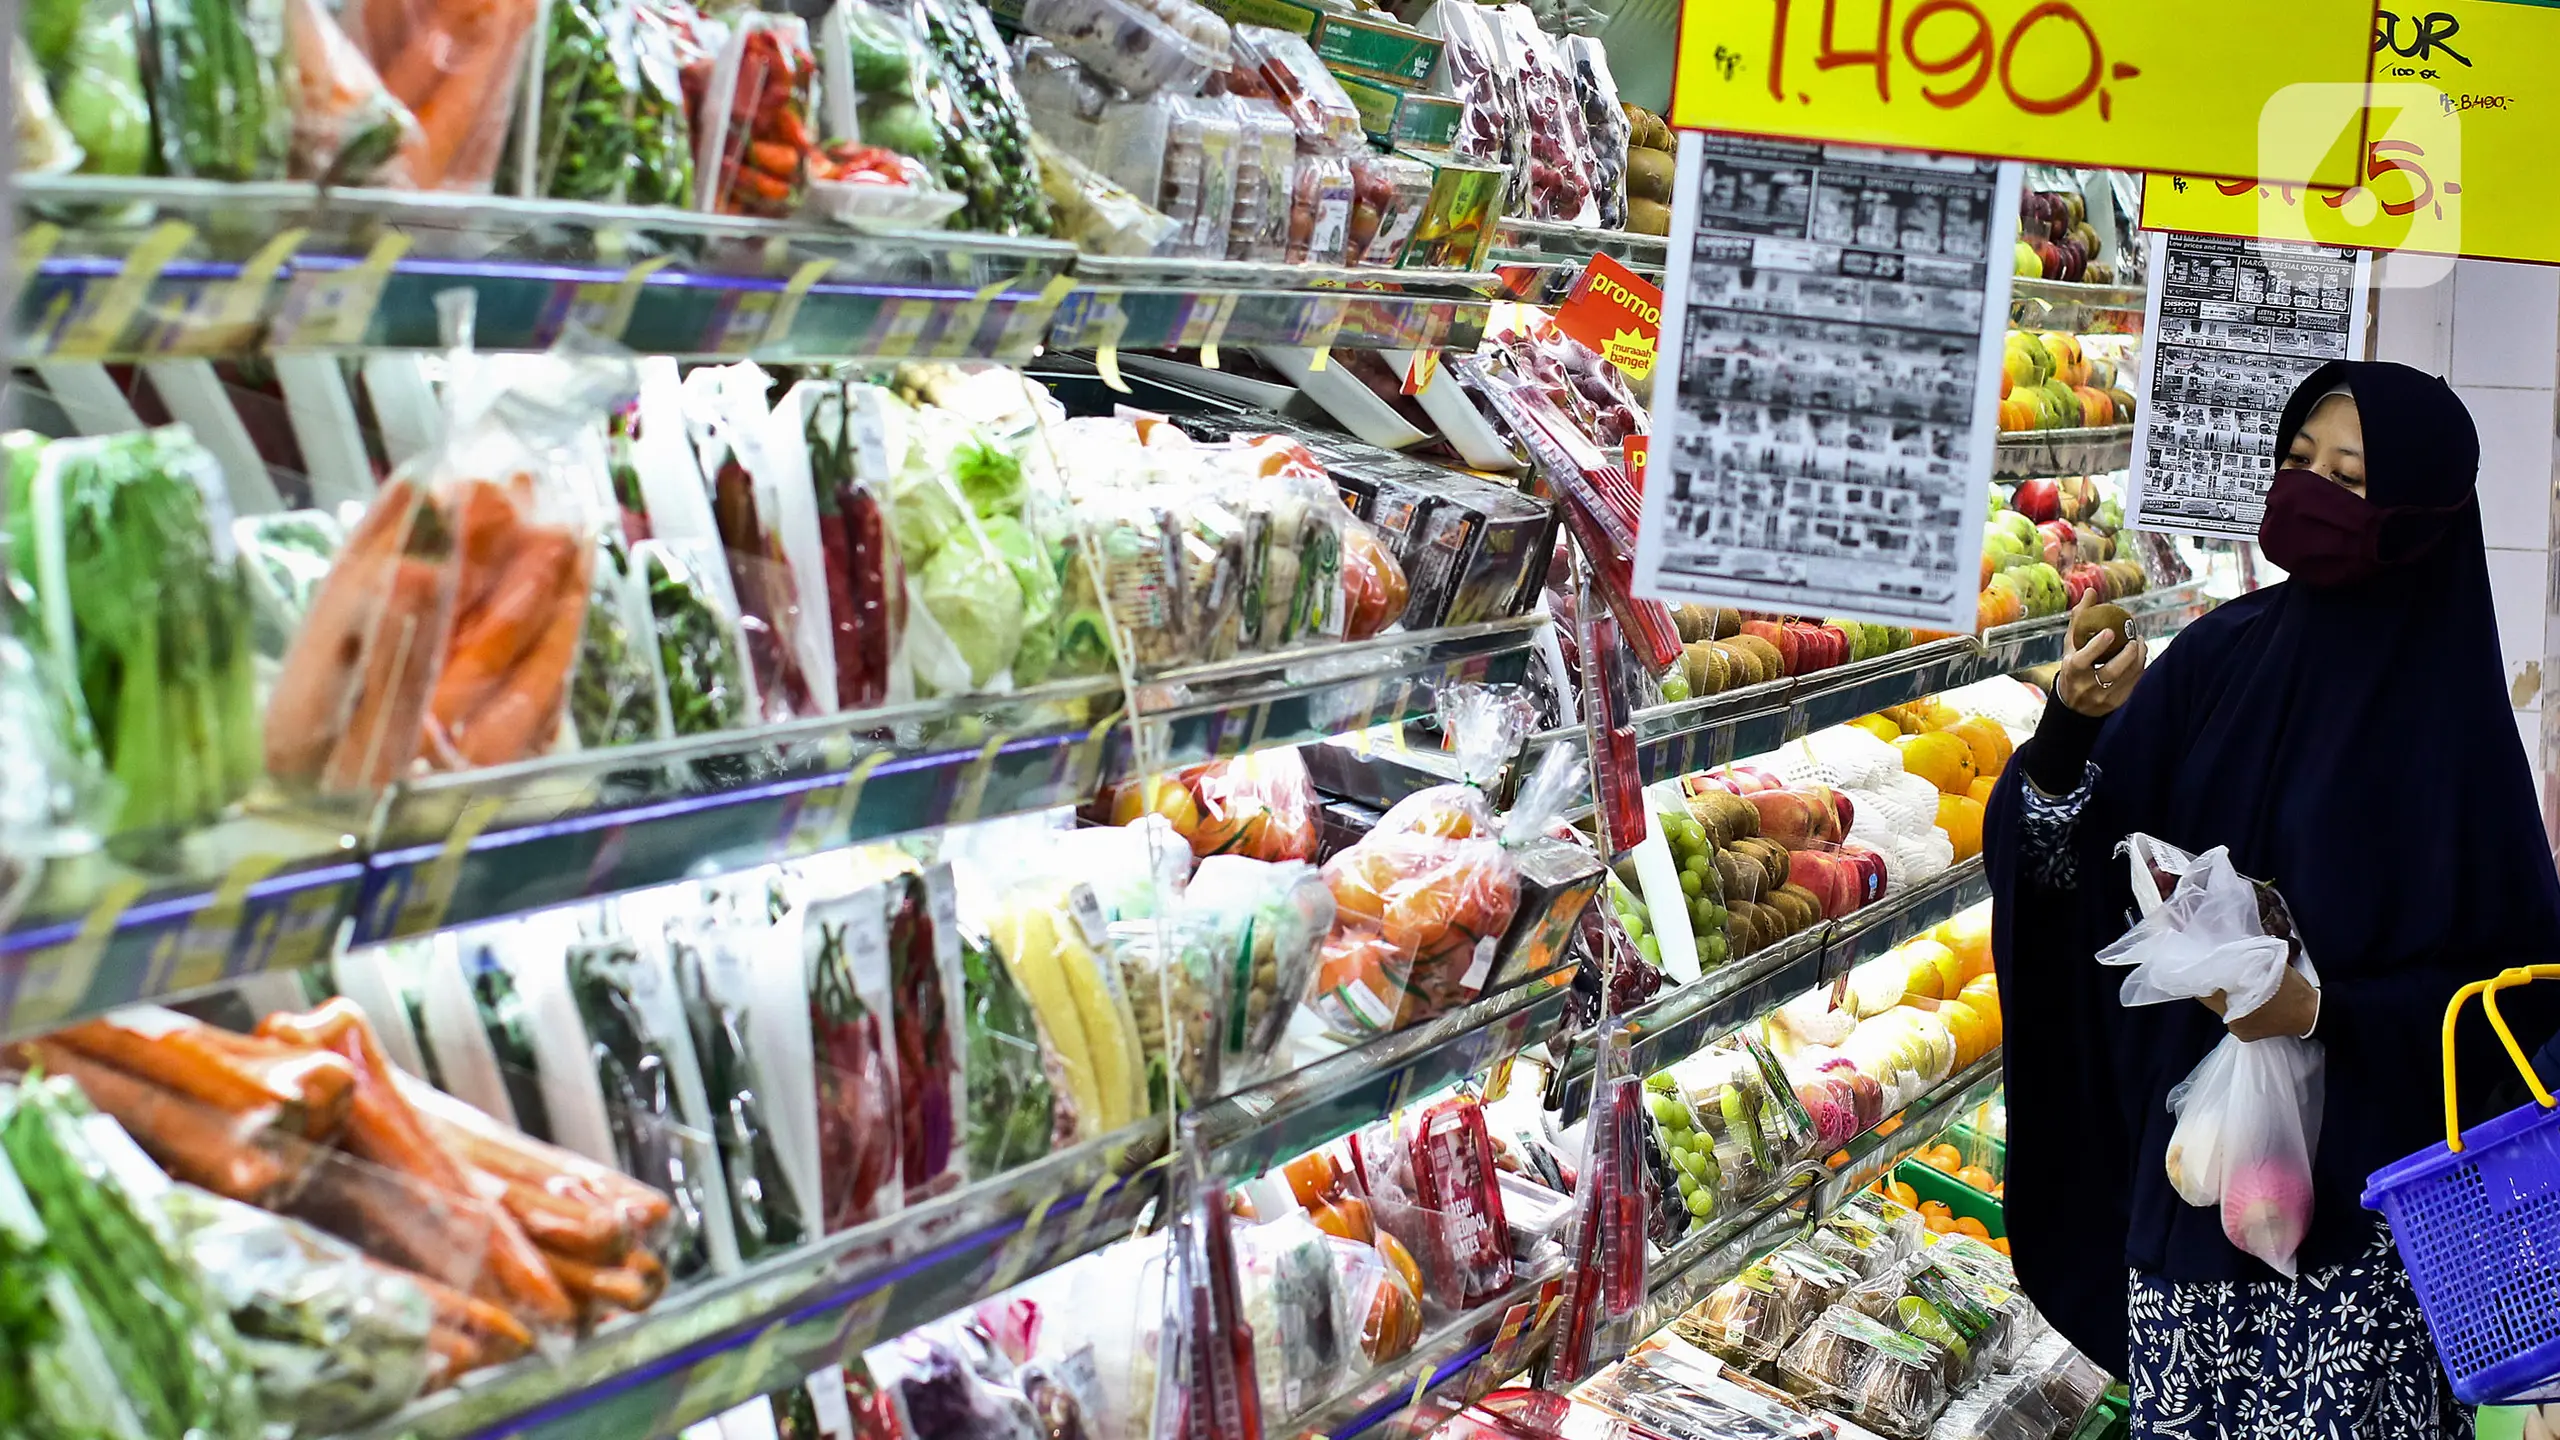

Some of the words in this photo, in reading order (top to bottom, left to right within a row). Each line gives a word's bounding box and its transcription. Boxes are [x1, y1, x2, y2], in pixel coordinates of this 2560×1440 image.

[2183, 241, 2202, 250] prices
[2203, 243, 2216, 251] and
[2241, 258, 2269, 269] HARGA
[2270, 261, 2300, 271] SPESIAL
[2301, 264, 2319, 272] OVO
[2319, 265, 2340, 274] CASH
[2164, 300, 2198, 308] DISKON
[1612, 343, 1652, 359] muraaah
[1609, 350, 1650, 370] banget
